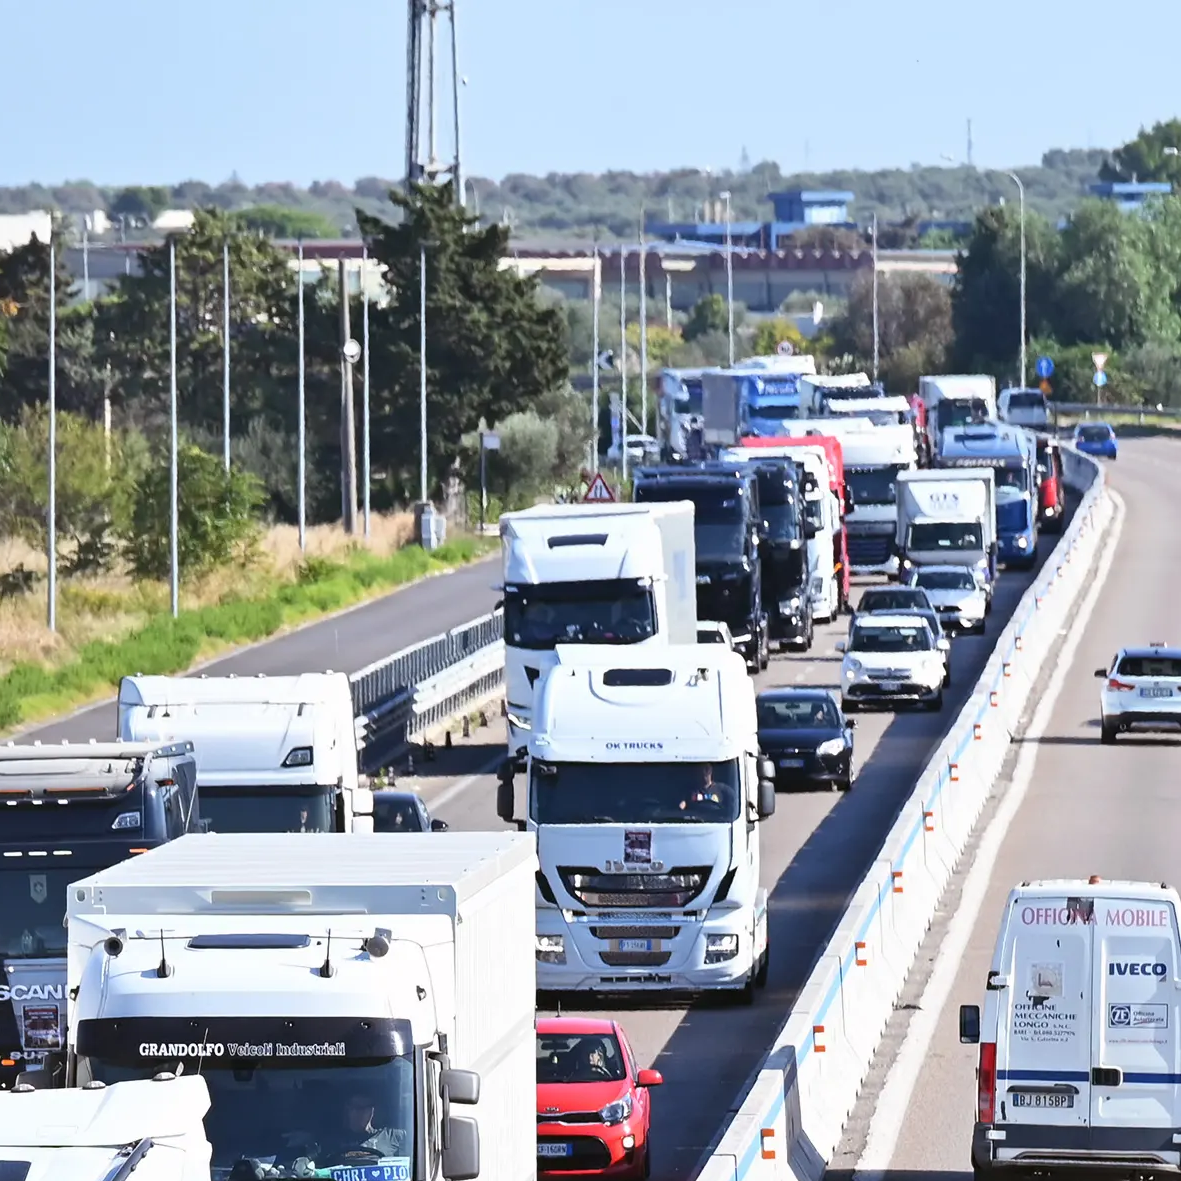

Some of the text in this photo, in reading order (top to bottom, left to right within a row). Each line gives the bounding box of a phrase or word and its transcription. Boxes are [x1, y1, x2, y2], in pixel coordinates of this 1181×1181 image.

[605, 742, 664, 750] OK TRUCKS
[1106, 908, 1167, 928] MOBILE
[1109, 962, 1167, 977] IVECO
[1014, 1012, 1078, 1021] MECCANICHE
[1113, 1009, 1128, 1021] ZF
[1014, 1021, 1049, 1029] LONGO
[139, 1041, 346, 1057] GRANDOLFO Veicoli Industriali
[383, 1166, 408, 1180] PIO
